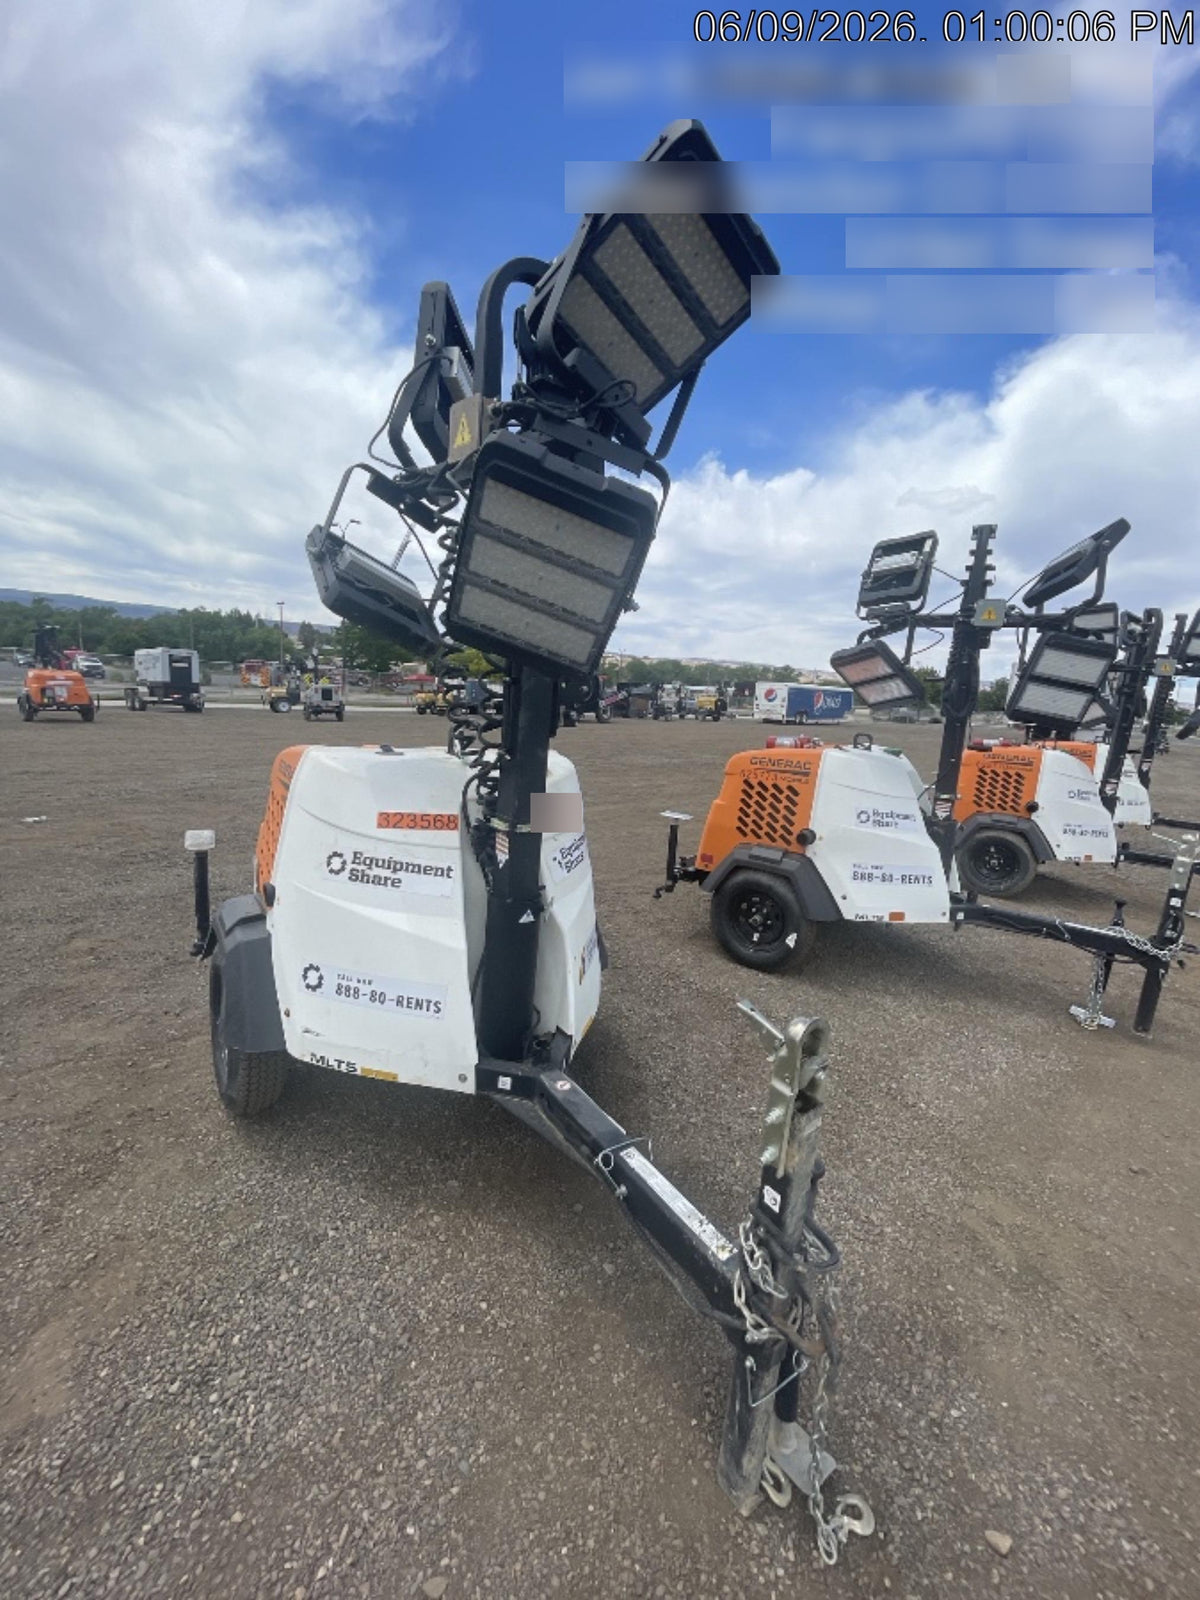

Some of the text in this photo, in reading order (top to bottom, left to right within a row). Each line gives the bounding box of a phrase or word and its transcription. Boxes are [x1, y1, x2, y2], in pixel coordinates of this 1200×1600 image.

[750, 757, 811, 770] GENERAC
[378, 812, 458, 830] 323568
[351, 851, 454, 879] Equipment
[348, 867, 402, 889] Share
[335, 982, 442, 1014] 888-80-RENTS
